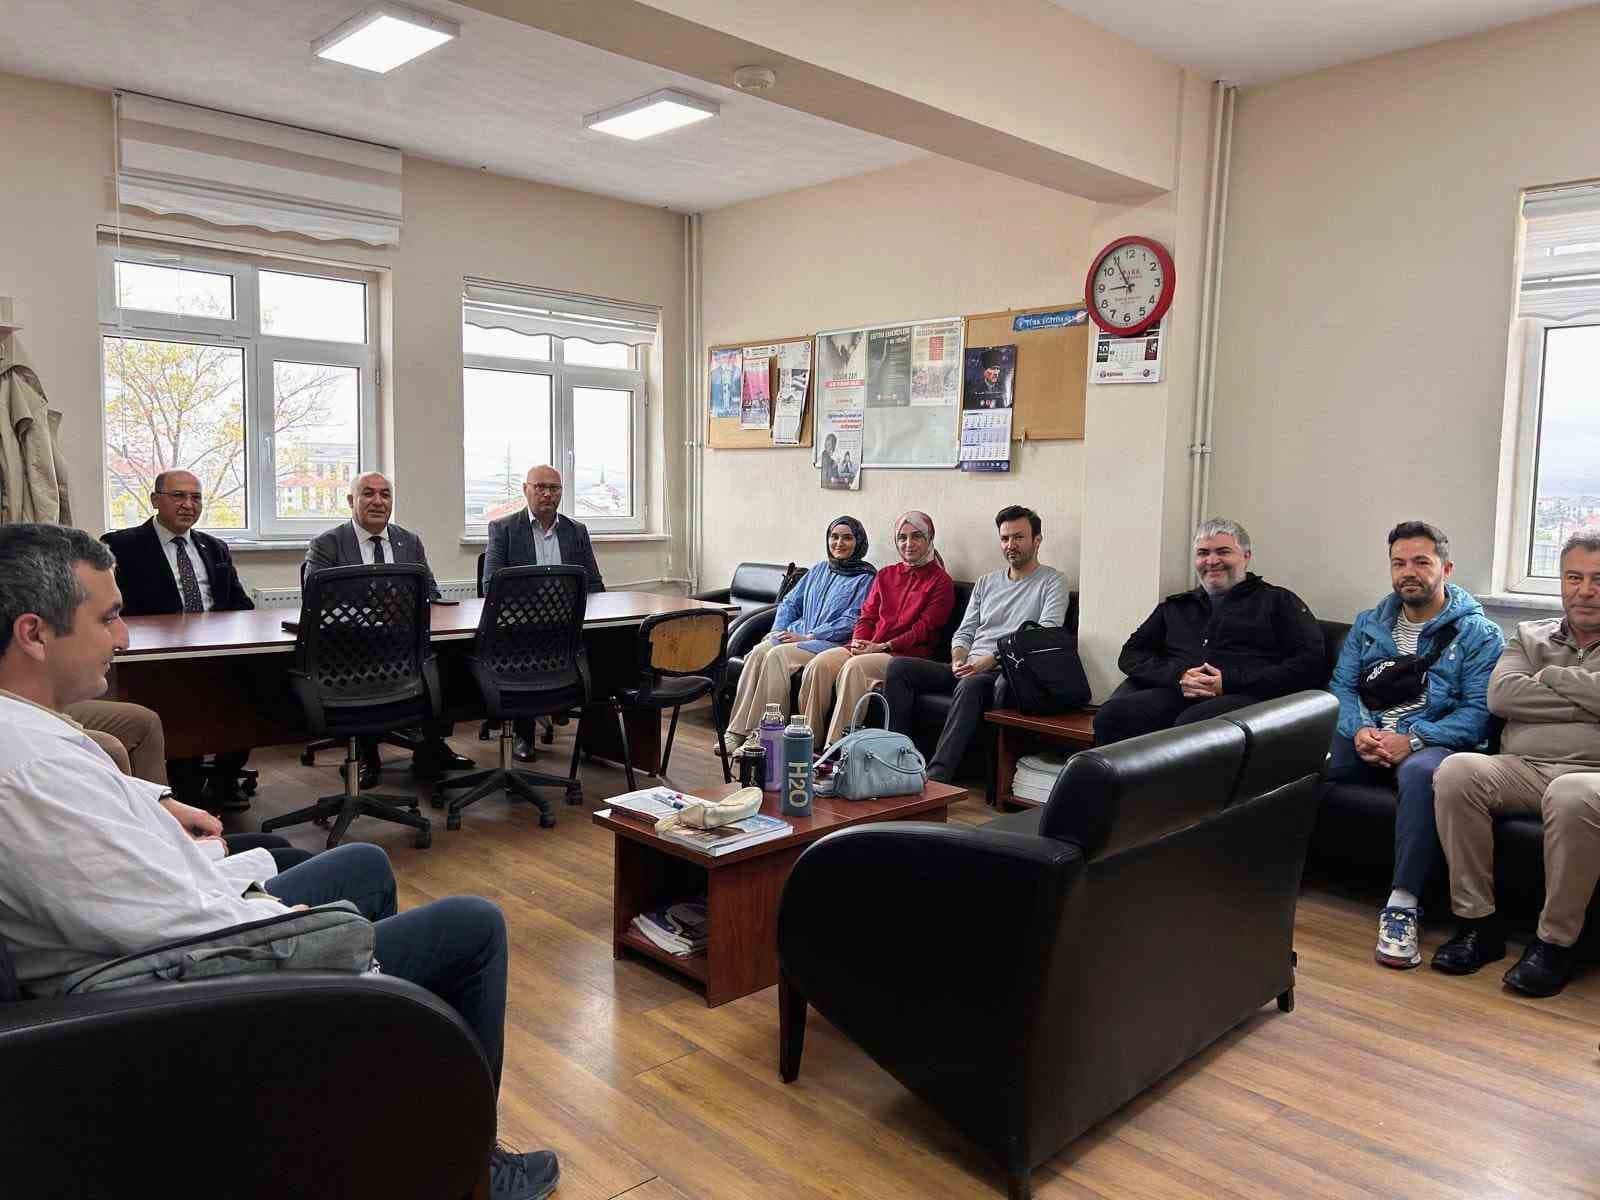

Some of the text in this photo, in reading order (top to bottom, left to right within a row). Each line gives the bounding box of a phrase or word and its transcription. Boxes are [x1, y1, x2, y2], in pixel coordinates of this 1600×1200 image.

[1126, 249, 1136, 259] 12
[1142, 252, 1146, 261] 1
[1149, 262, 1157, 271] 2
[1104, 267, 1114, 276] 10
[1154, 278, 1160, 287] 3
[1098, 284, 1105, 293] 9
[1149, 295, 1155, 304] 4
[1101, 300, 1108, 309] 8
[1110, 309, 1116, 318] 7
[1139, 307, 1146, 316] 5
[1124, 313, 1131, 322] 6
[1366, 661, 1396, 682] adidas
[788, 762, 808, 807] H2O
